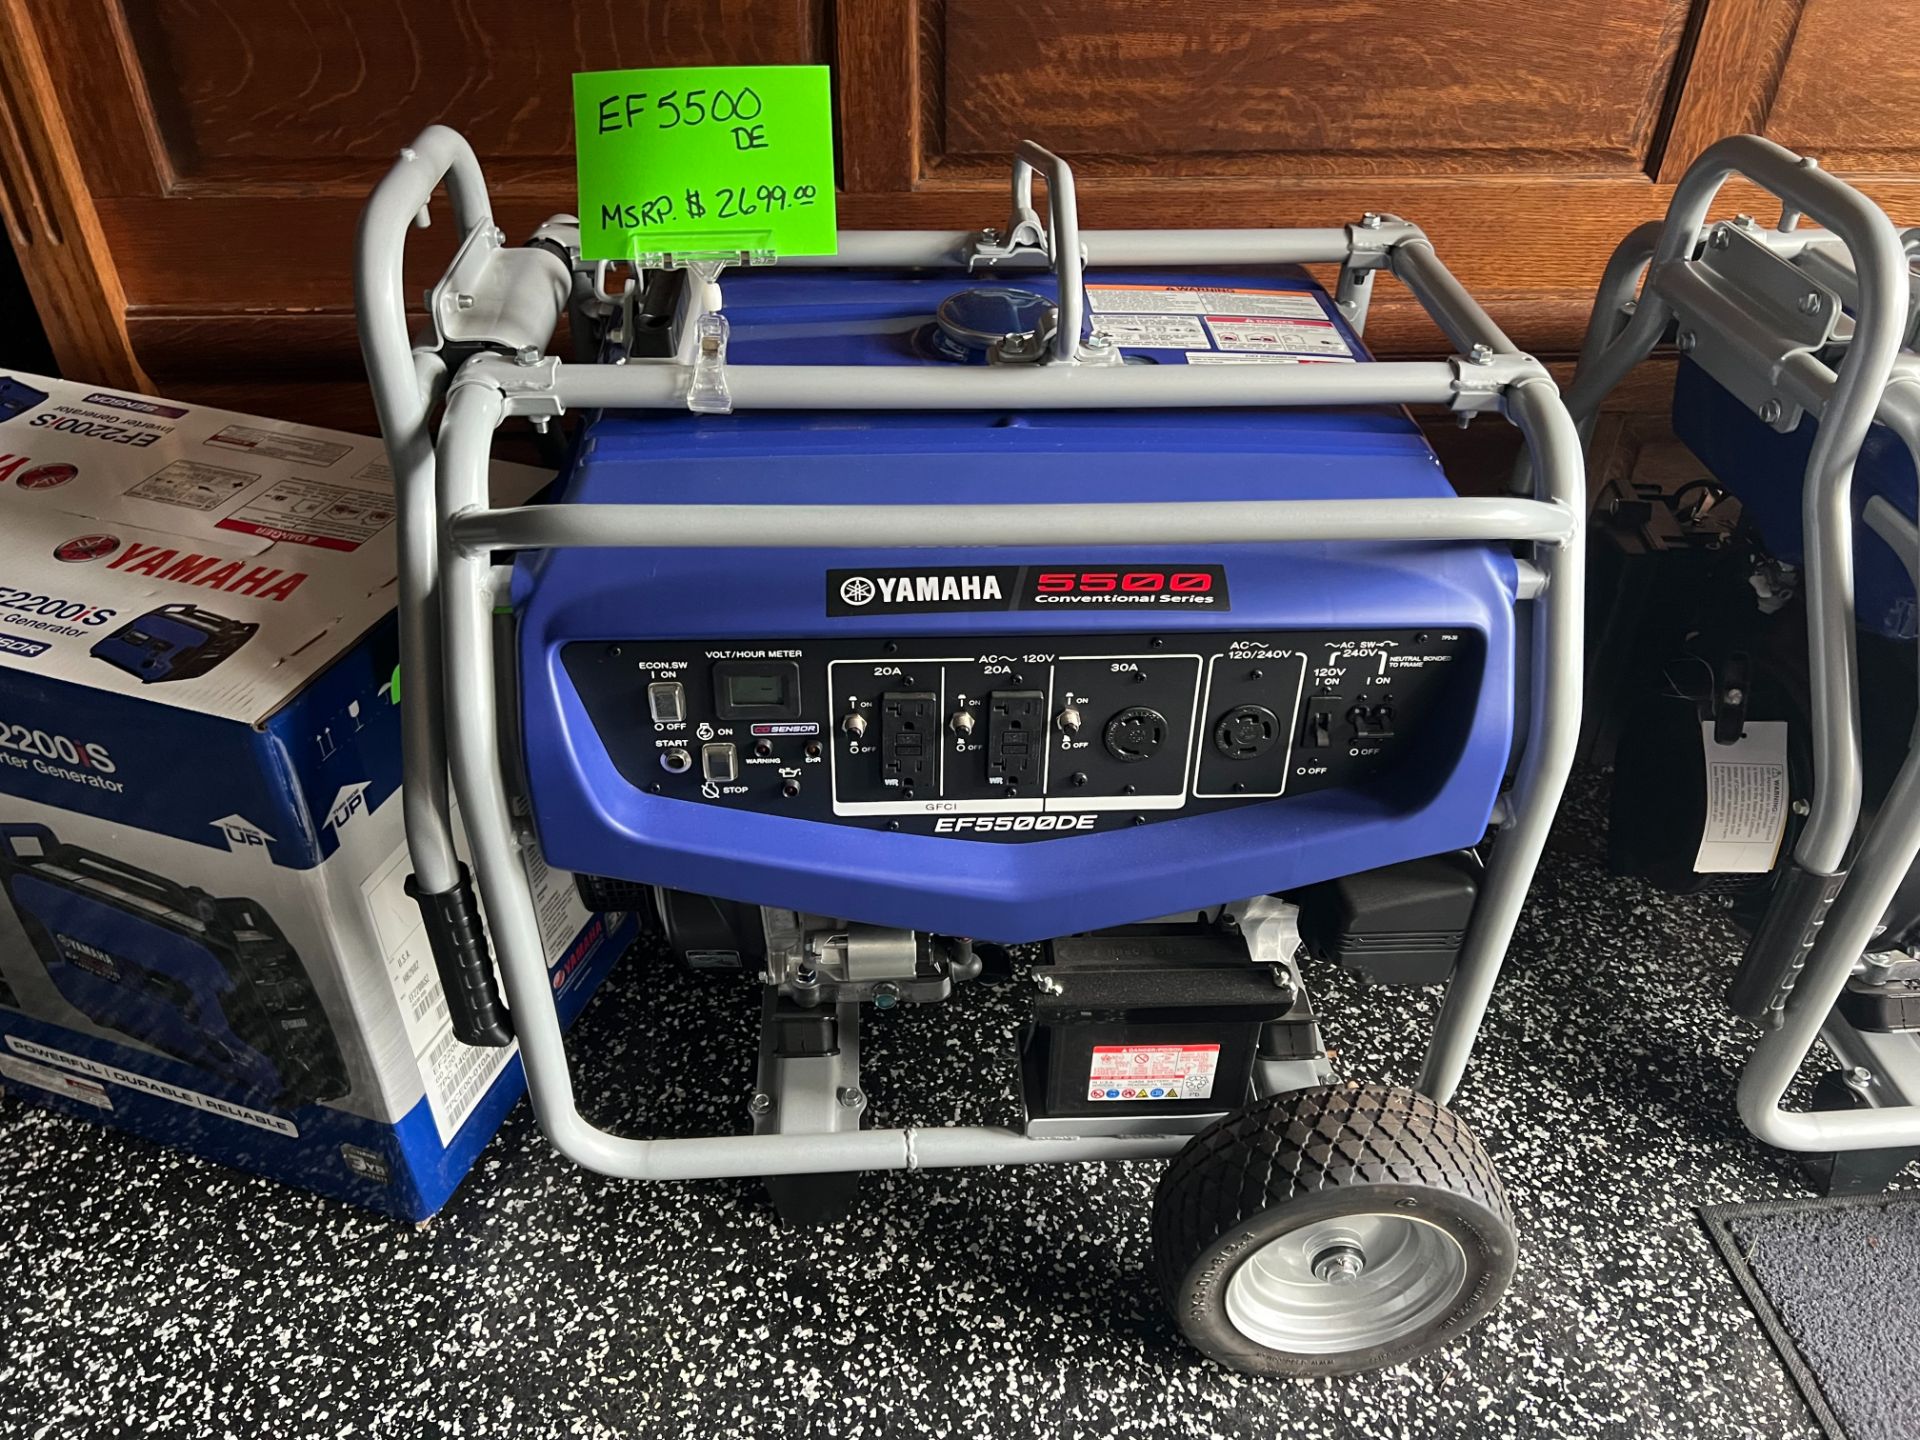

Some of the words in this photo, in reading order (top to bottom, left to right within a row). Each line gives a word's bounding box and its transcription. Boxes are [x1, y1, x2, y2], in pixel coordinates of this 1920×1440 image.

[731, 124, 769, 151] DE
[88, 395, 160, 412] SENSOR
[53, 404, 120, 424] Generator
[29, 413, 162, 448] EF2200iS
[120, 418, 176, 434] Inverter
[106, 542, 309, 602] YAMAHA
[877, 575, 1002, 603] YAMAHA
[1038, 573, 1213, 592] 5500
[1035, 594, 1157, 605] Conventional
[1160, 594, 1214, 604] Series
[4, 613, 89, 639] Generator
[0, 637, 44, 655] SOR
[1360, 641, 1377, 649] SW
[705, 650, 766, 660] VOLT/HOUR
[768, 650, 803, 658] METER
[1228, 650, 1292, 659] 120/240V
[1343, 649, 1378, 657] 240V
[1022, 654, 1056, 664] 120V
[639, 661, 688, 671] ECON.SW
[874, 666, 902, 676] 20A
[984, 665, 1012, 674] 20A
[1111, 663, 1139, 672] 30A
[660, 671, 676, 679] ON
[1314, 668, 1346, 677] 120V
[1375, 677, 1391, 685] ON
[666, 723, 687, 731] OFF
[718, 728, 733, 736] ON
[655, 739, 689, 748] START
[1361, 748, 1380, 756] OFF
[32, 758, 124, 794] Generator
[1308, 767, 1327, 775] OFF
[723, 786, 749, 795] STOP
[334, 794, 363, 829] UP
[925, 802, 958, 812] GFCI
[935, 815, 1098, 834] EF5500DE
[228, 826, 265, 847] UP
[13, 1040, 103, 1075] POWERFUL
[114, 1072, 194, 1102] DURABLE
[207, 1100, 289, 1131] RELIABLE
